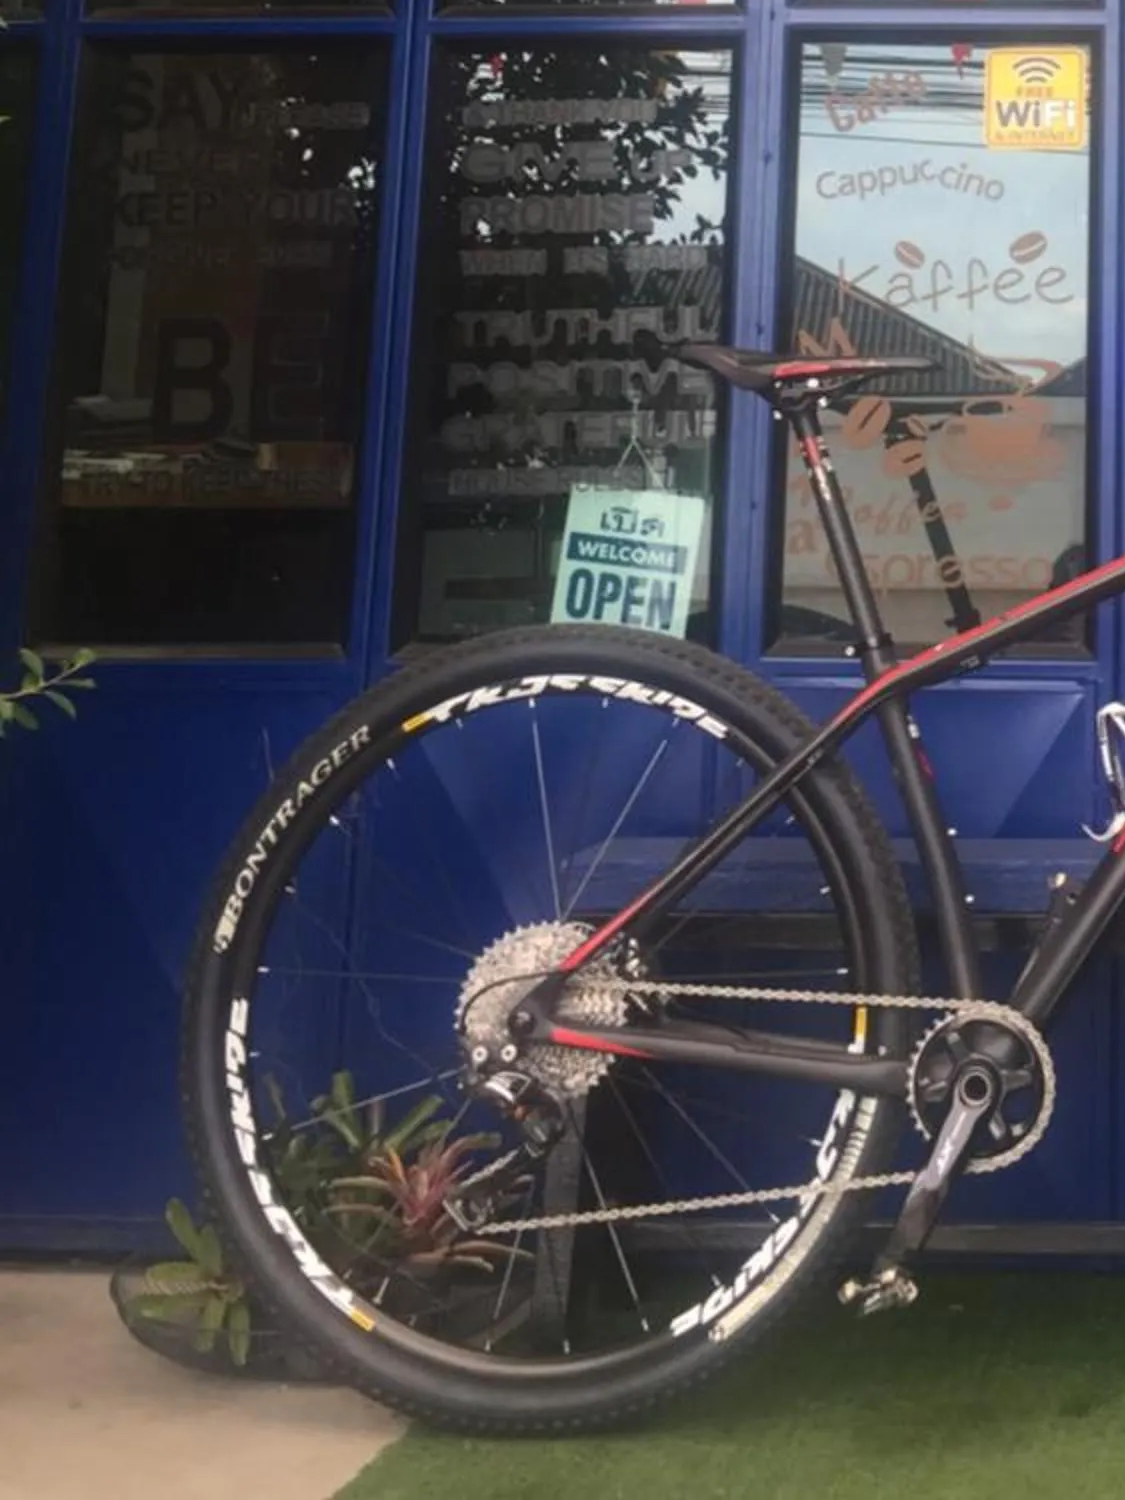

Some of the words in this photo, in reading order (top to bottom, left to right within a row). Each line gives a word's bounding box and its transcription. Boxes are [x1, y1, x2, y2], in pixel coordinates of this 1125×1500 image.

[995, 99, 1076, 128] WiFi
[815, 159, 1006, 202] Cappuccino
[461, 193, 653, 234] PROMISE
[837, 256, 1076, 312] Kaffee
[454, 308, 720, 345] TRUTHFUL
[447, 359, 714, 397] POSITIVE
[577, 539, 676, 568] WELCOME
[565, 567, 677, 631] OPEN
[224, 724, 371, 920] BONTRAGER
